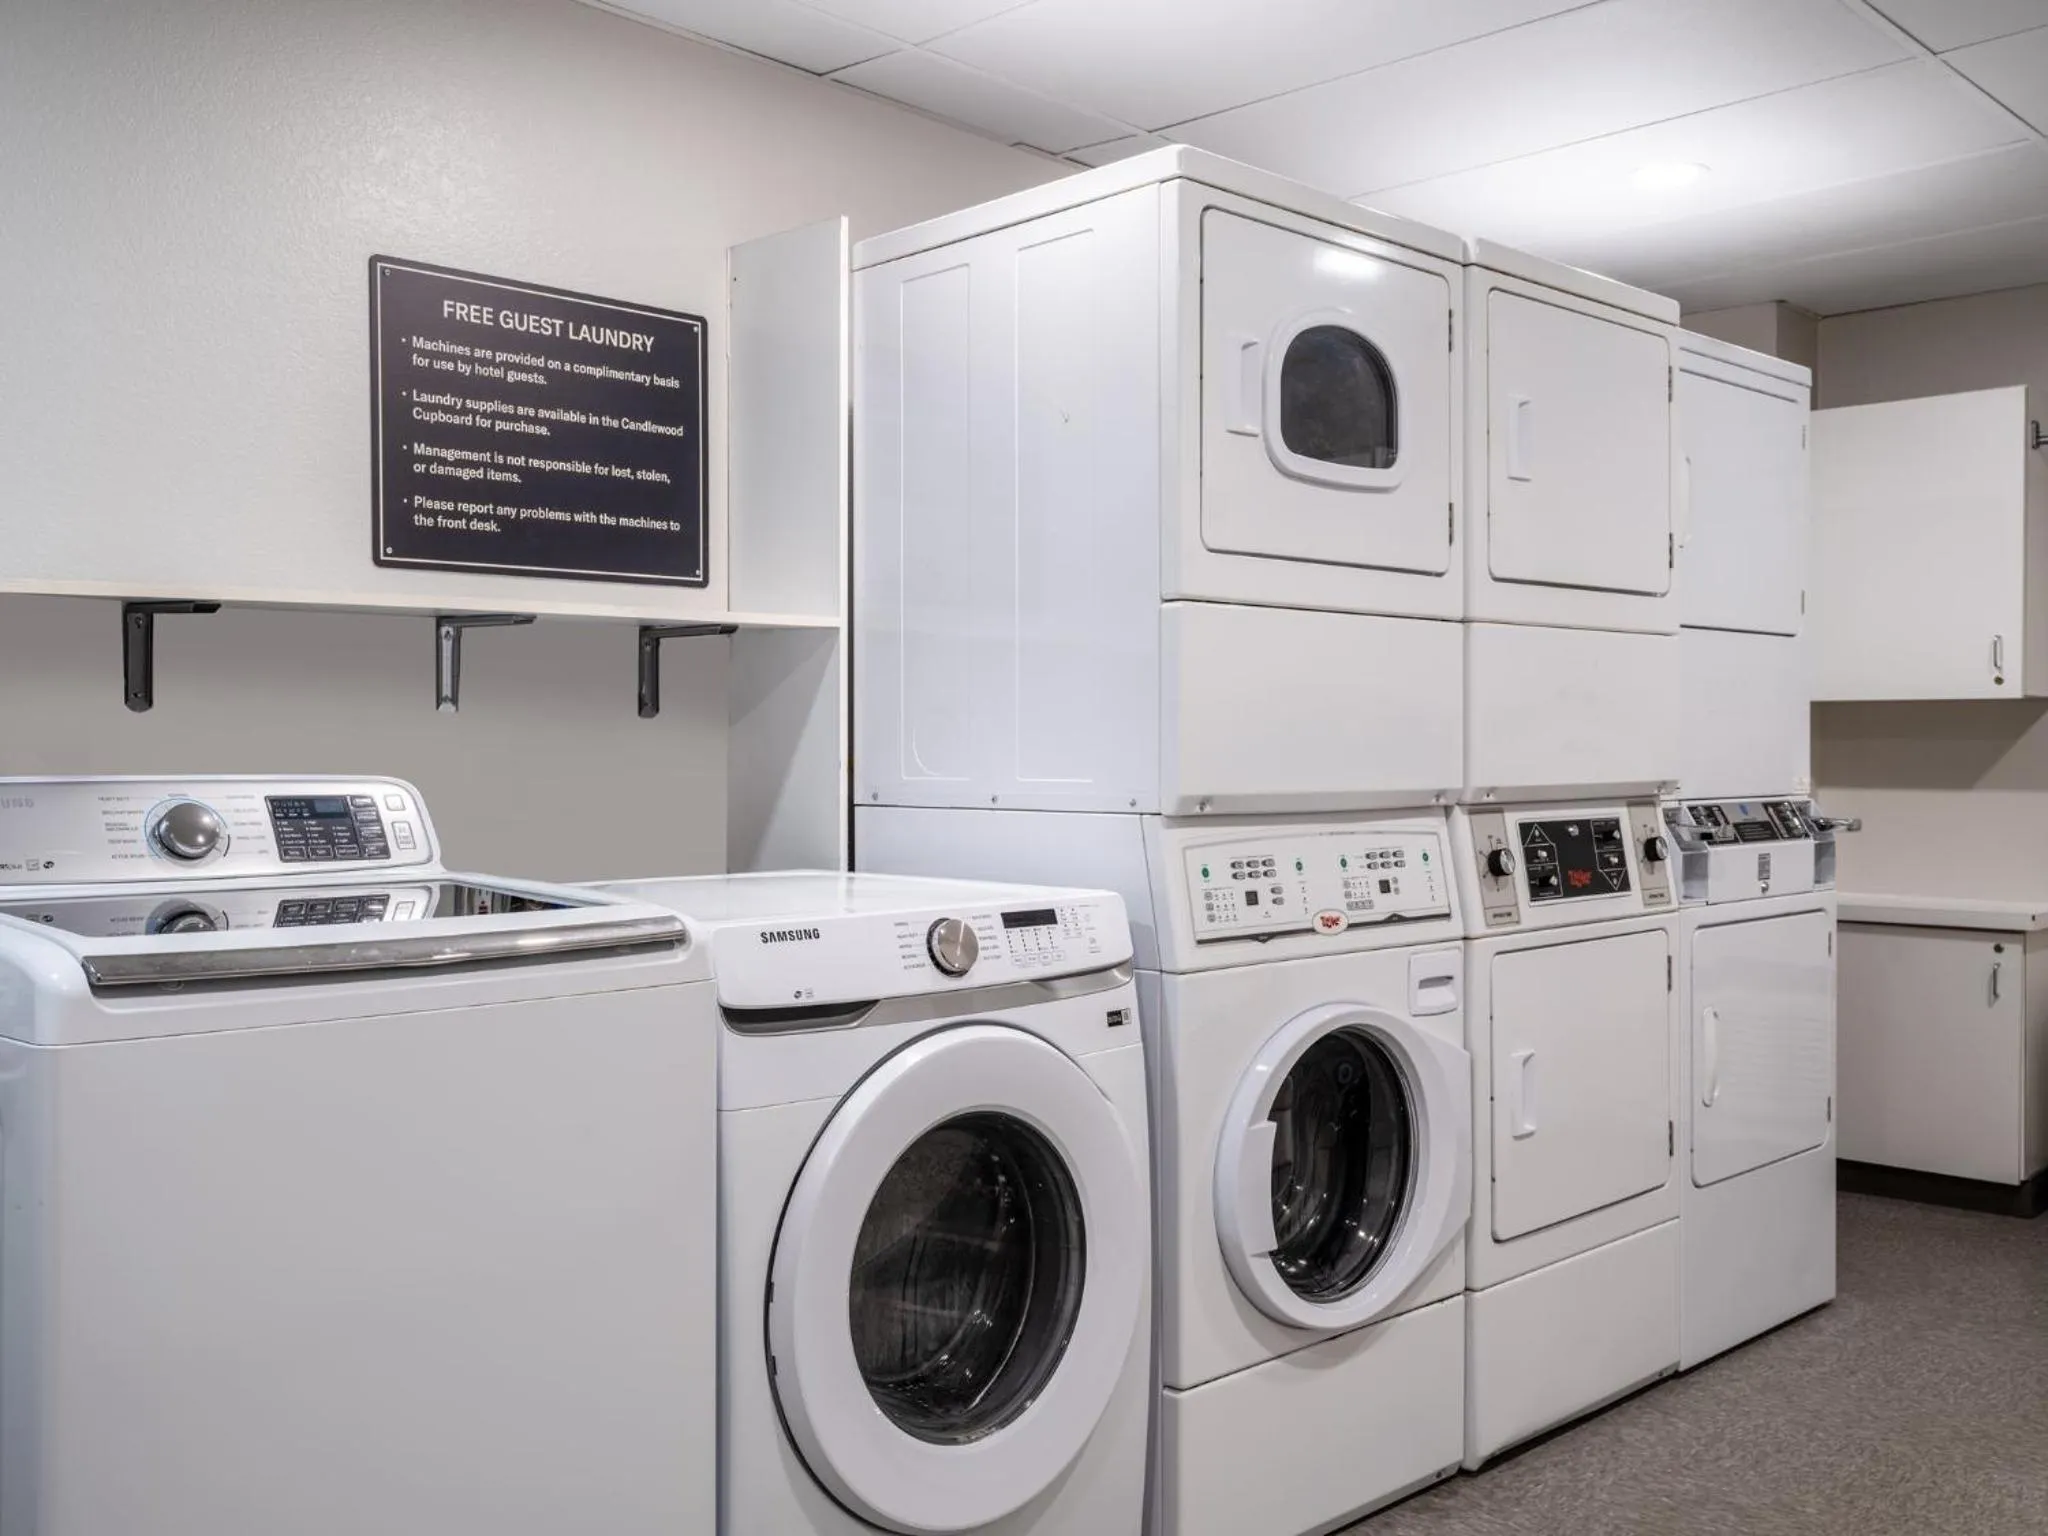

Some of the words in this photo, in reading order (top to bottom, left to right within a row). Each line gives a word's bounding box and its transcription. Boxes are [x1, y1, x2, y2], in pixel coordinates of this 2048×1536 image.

[443, 300, 494, 326] FREE
[499, 310, 565, 337] GUEST
[569, 322, 655, 353] LAUNDRY
[412, 336, 471, 356] Machines
[474, 348, 493, 360] are
[495, 352, 545, 368] provided
[547, 360, 562, 370] on
[563, 362, 572, 372] a
[573, 364, 652, 387] complimentary
[653, 373, 680, 389] basis
[412, 353, 430, 368] for
[433, 360, 455, 371] use
[457, 360, 472, 376] by
[475, 363, 504, 379] hotel
[506, 370, 547, 385] guests.
[412, 409, 473, 426] Cupboard
[475, 415, 492, 429] for
[495, 420, 551, 437] purchase.
[413, 389, 463, 410] Laundry
[465, 399, 515, 415] supplies
[517, 406, 536, 417] are
[537, 408, 587, 424] available
[589, 413, 600, 426] in
[601, 415, 620, 429] the
[621, 417, 684, 437] Candlewood
[413, 443, 492, 463] Management
[494, 451, 505, 464] is
[507, 455, 527, 467] not
[528, 458, 593, 474] responsible
[594, 462, 610, 476] for
[611, 464, 635, 480] lost,
[636, 469, 671, 485] stolen,
[413, 463, 427, 474] or
[429, 462, 484, 481] damaged
[487, 468, 522, 483] items.
[413, 513, 435, 527] the
[437, 515, 467, 530] front
[469, 518, 501, 533] desk.
[414, 496, 455, 511] Please
[457, 502, 494, 516] report
[496, 506, 518, 520] any
[520, 507, 572, 522] problems
[573, 511, 598, 524] with
[599, 513, 617, 526] the
[619, 516, 669, 531] machines
[669, 520, 681, 532] to
[761, 928, 820, 944] SAMSUNG
